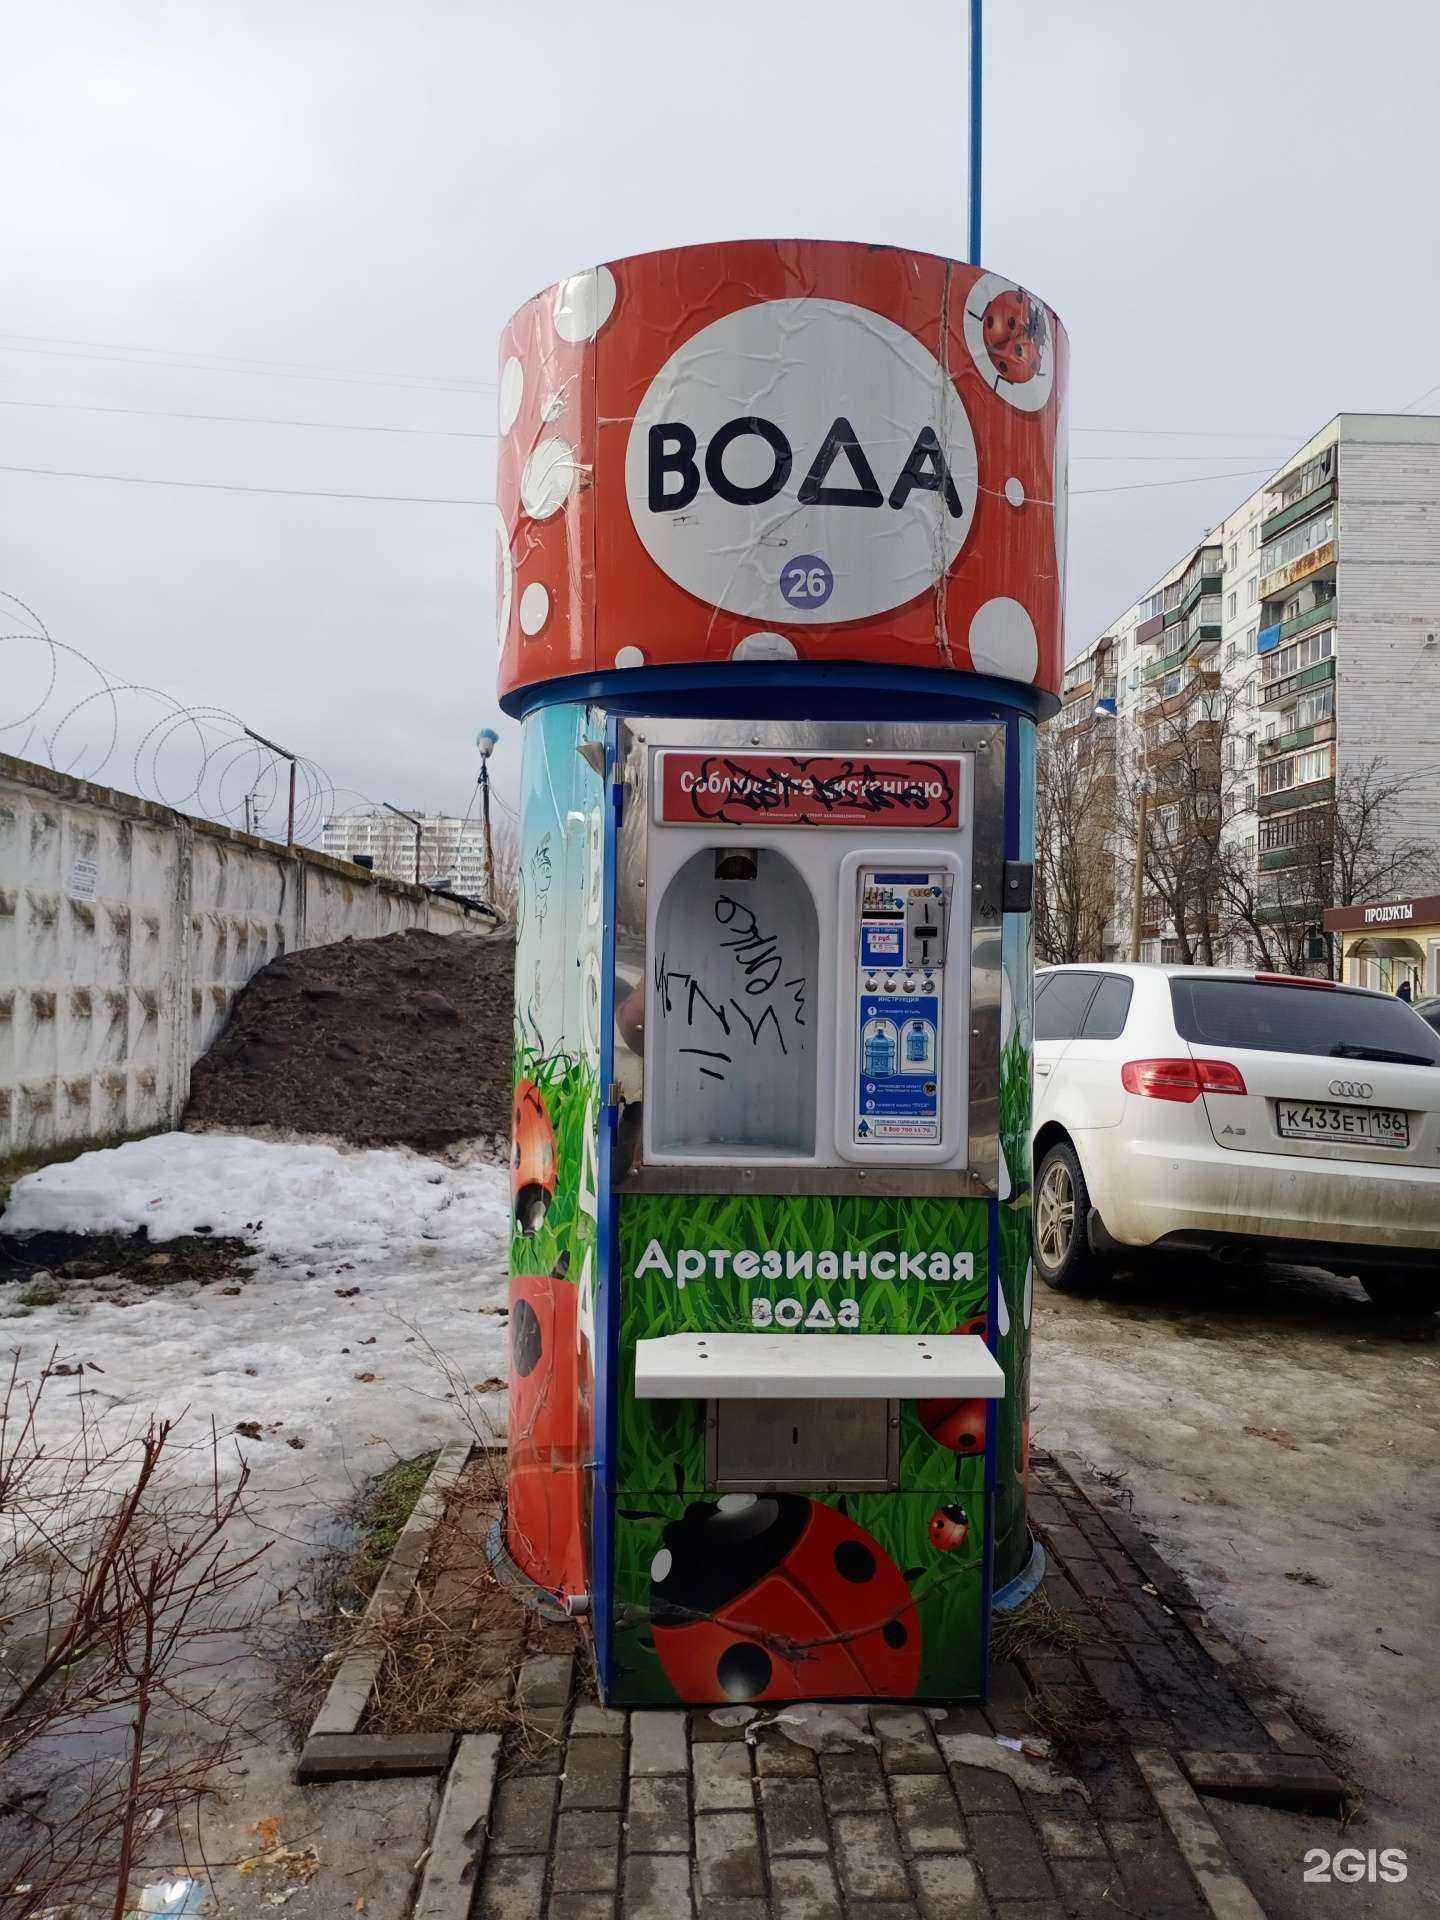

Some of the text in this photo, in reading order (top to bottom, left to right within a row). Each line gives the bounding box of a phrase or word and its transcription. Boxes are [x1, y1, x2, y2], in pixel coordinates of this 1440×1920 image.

[648, 416, 964, 519] ВОДА
[787, 568, 826, 598] 26
[1364, 904, 1414, 923] ПРОДУКТЫ
[1372, 1112, 1403, 1130] 136
[634, 1239, 974, 1290] Артезианская
[751, 1297, 860, 1328] вода
